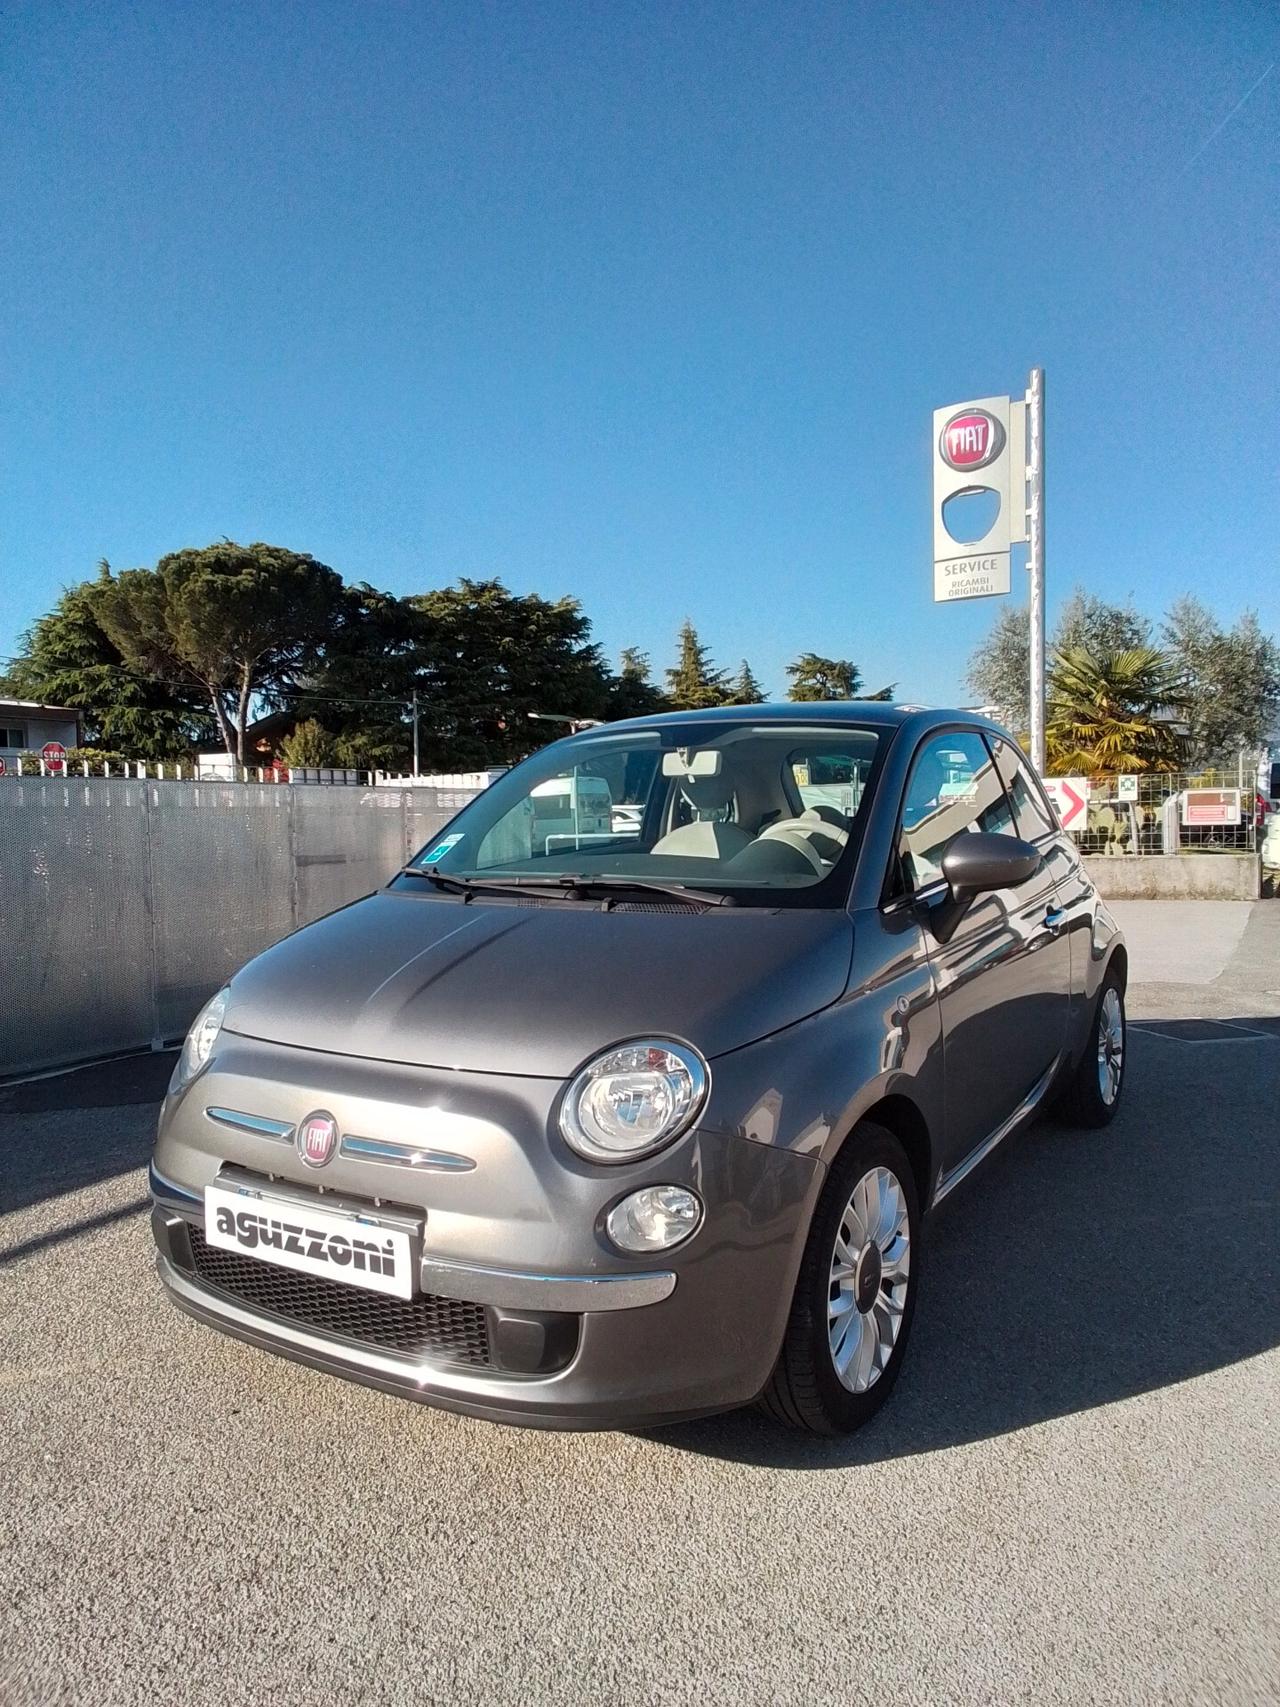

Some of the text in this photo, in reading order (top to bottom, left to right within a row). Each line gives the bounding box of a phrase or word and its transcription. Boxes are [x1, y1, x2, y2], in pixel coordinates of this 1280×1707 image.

[949, 424, 986, 456] FIAT
[944, 559, 998, 576] SERVICE
[951, 576, 989, 588] RICAMBI
[948, 585, 993, 597] ORIGINALI
[43, 751, 66, 761] STOP
[307, 1127, 332, 1153] FIAT
[216, 1206, 396, 1278] aguzzoni
